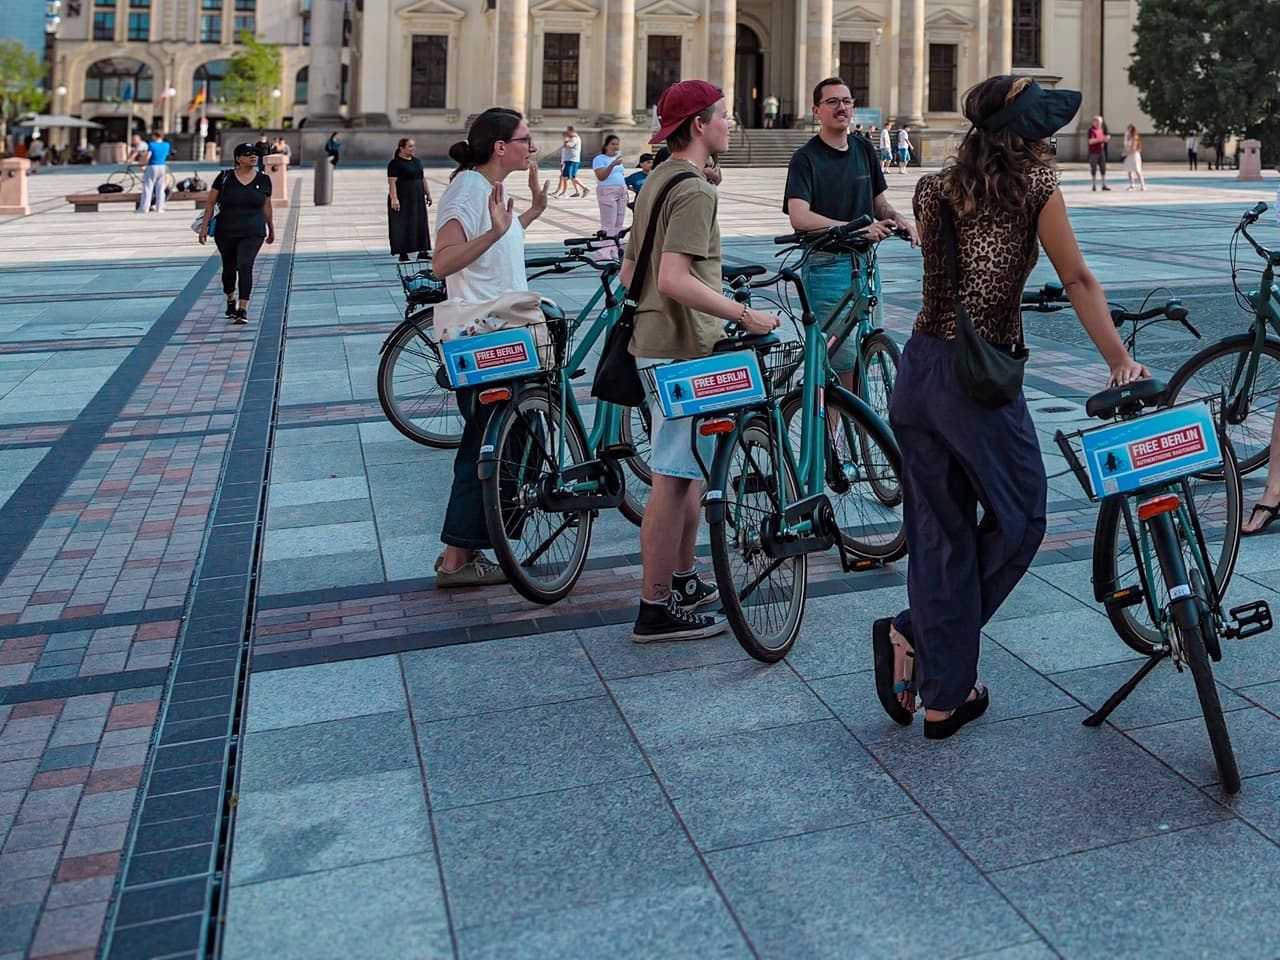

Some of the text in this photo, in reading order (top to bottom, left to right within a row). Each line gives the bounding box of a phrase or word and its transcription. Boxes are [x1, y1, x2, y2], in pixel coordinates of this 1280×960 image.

[476, 349, 497, 361] FREE
[496, 344, 524, 357] BERLIN
[694, 376, 717, 389] FREE
[716, 370, 747, 384] BERLIN
[1132, 439, 1160, 456] FREE
[1160, 428, 1199, 448] BERLIN
